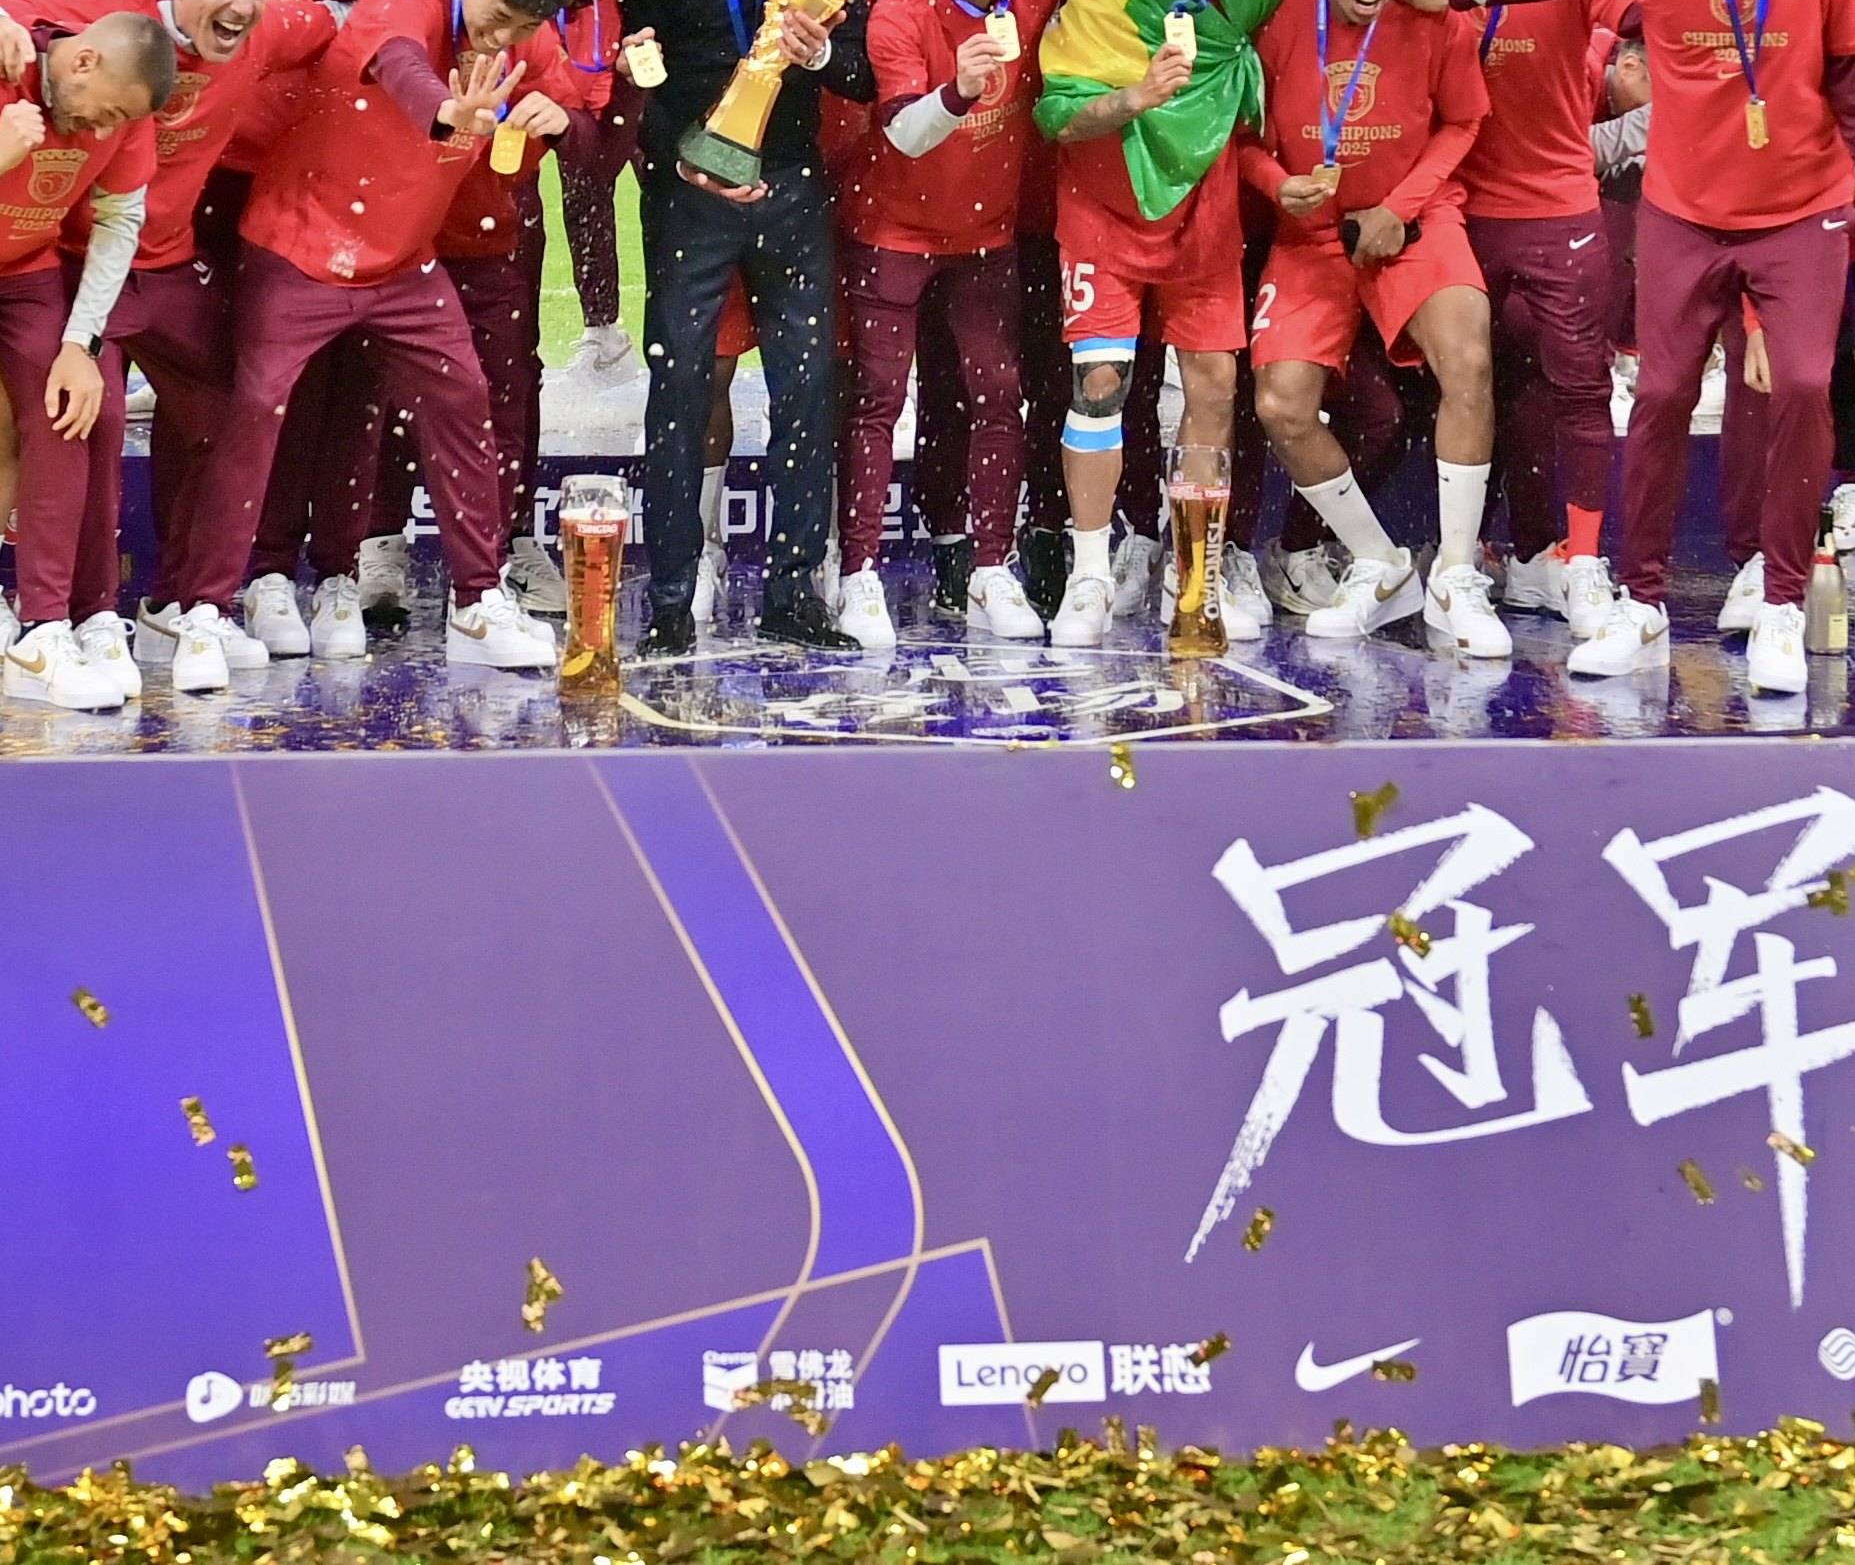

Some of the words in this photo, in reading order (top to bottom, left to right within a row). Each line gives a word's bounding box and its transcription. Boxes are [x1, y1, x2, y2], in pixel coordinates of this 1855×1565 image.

[1489, 37, 1537, 53] PIONS
[1301, 124, 1402, 141] CHMPIONS
[447, 136, 475, 150] 025
[1334, 141, 1371, 156] 2025
[1203, 521, 1223, 621] TSINGTAO
[459, 1357, 602, 1394] 央视体育
[503, 1391, 617, 1418] SPORTS
